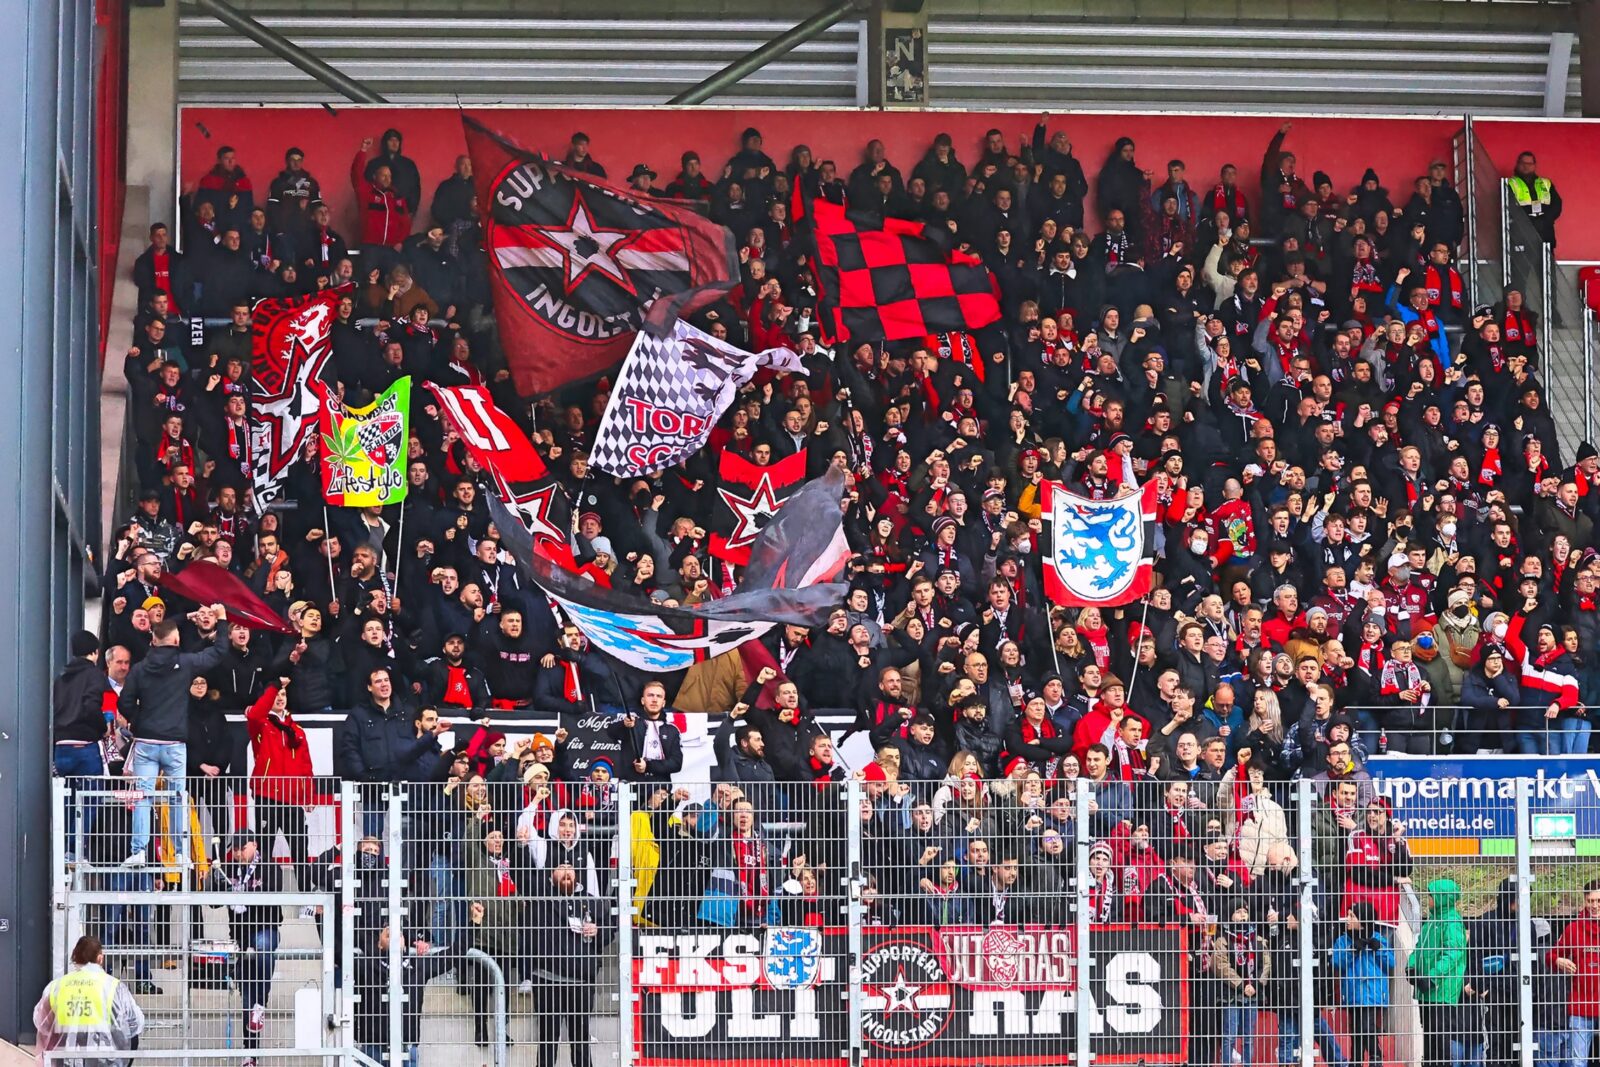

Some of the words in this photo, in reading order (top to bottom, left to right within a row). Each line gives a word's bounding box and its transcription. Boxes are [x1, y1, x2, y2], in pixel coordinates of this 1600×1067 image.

[590, 739, 622, 751] imme
[639, 934, 760, 985] FKS
[860, 946, 943, 982] SUPPORTERS
[66, 1000, 92, 1017] 365
[860, 1010, 943, 1045] INGOLSTADT
